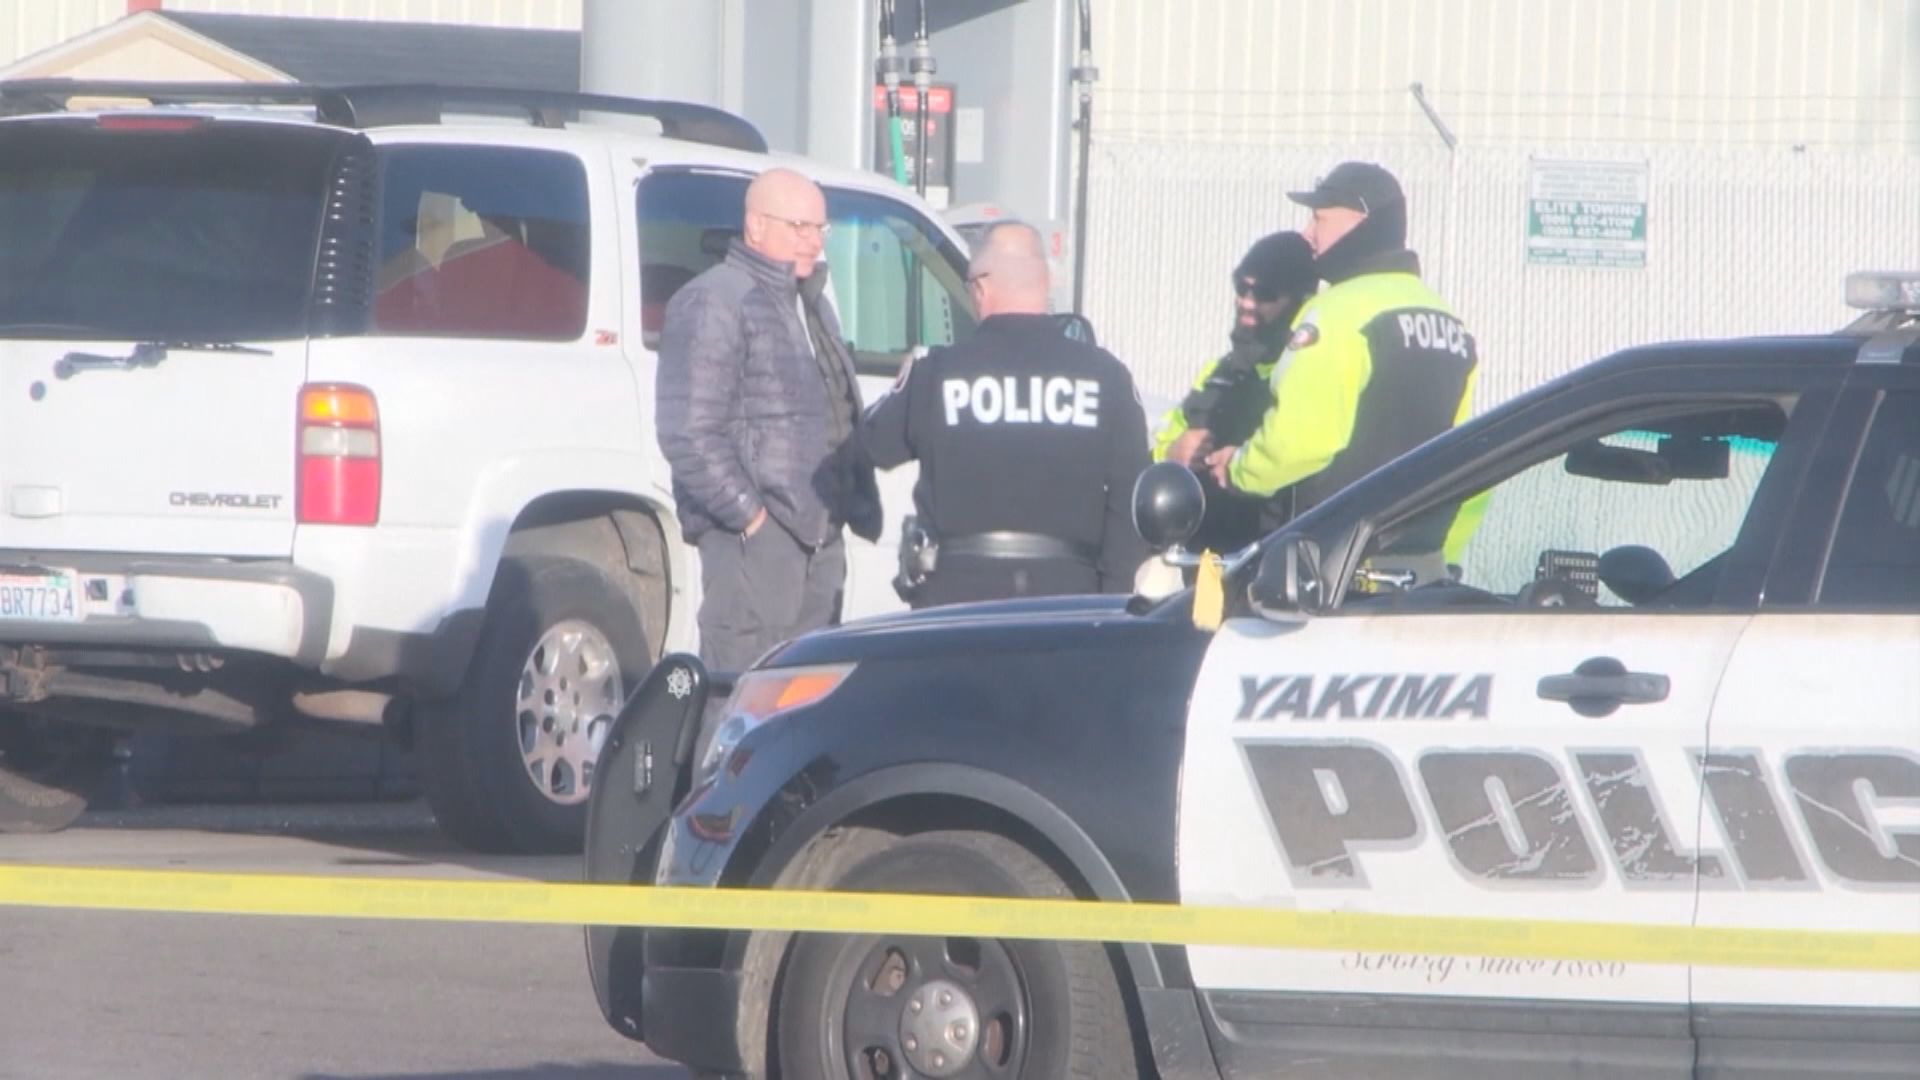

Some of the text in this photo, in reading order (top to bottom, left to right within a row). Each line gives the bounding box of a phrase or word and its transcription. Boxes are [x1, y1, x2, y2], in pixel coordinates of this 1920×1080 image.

[1535, 201, 1642, 217] ELITE TOWING
[1396, 312, 1468, 360] POLICE
[943, 376, 1099, 429] POLICE
[169, 492, 283, 509] CHEVROLET
[1233, 674, 1495, 722] YAKIMA
[1233, 737, 1919, 892] POLIC
